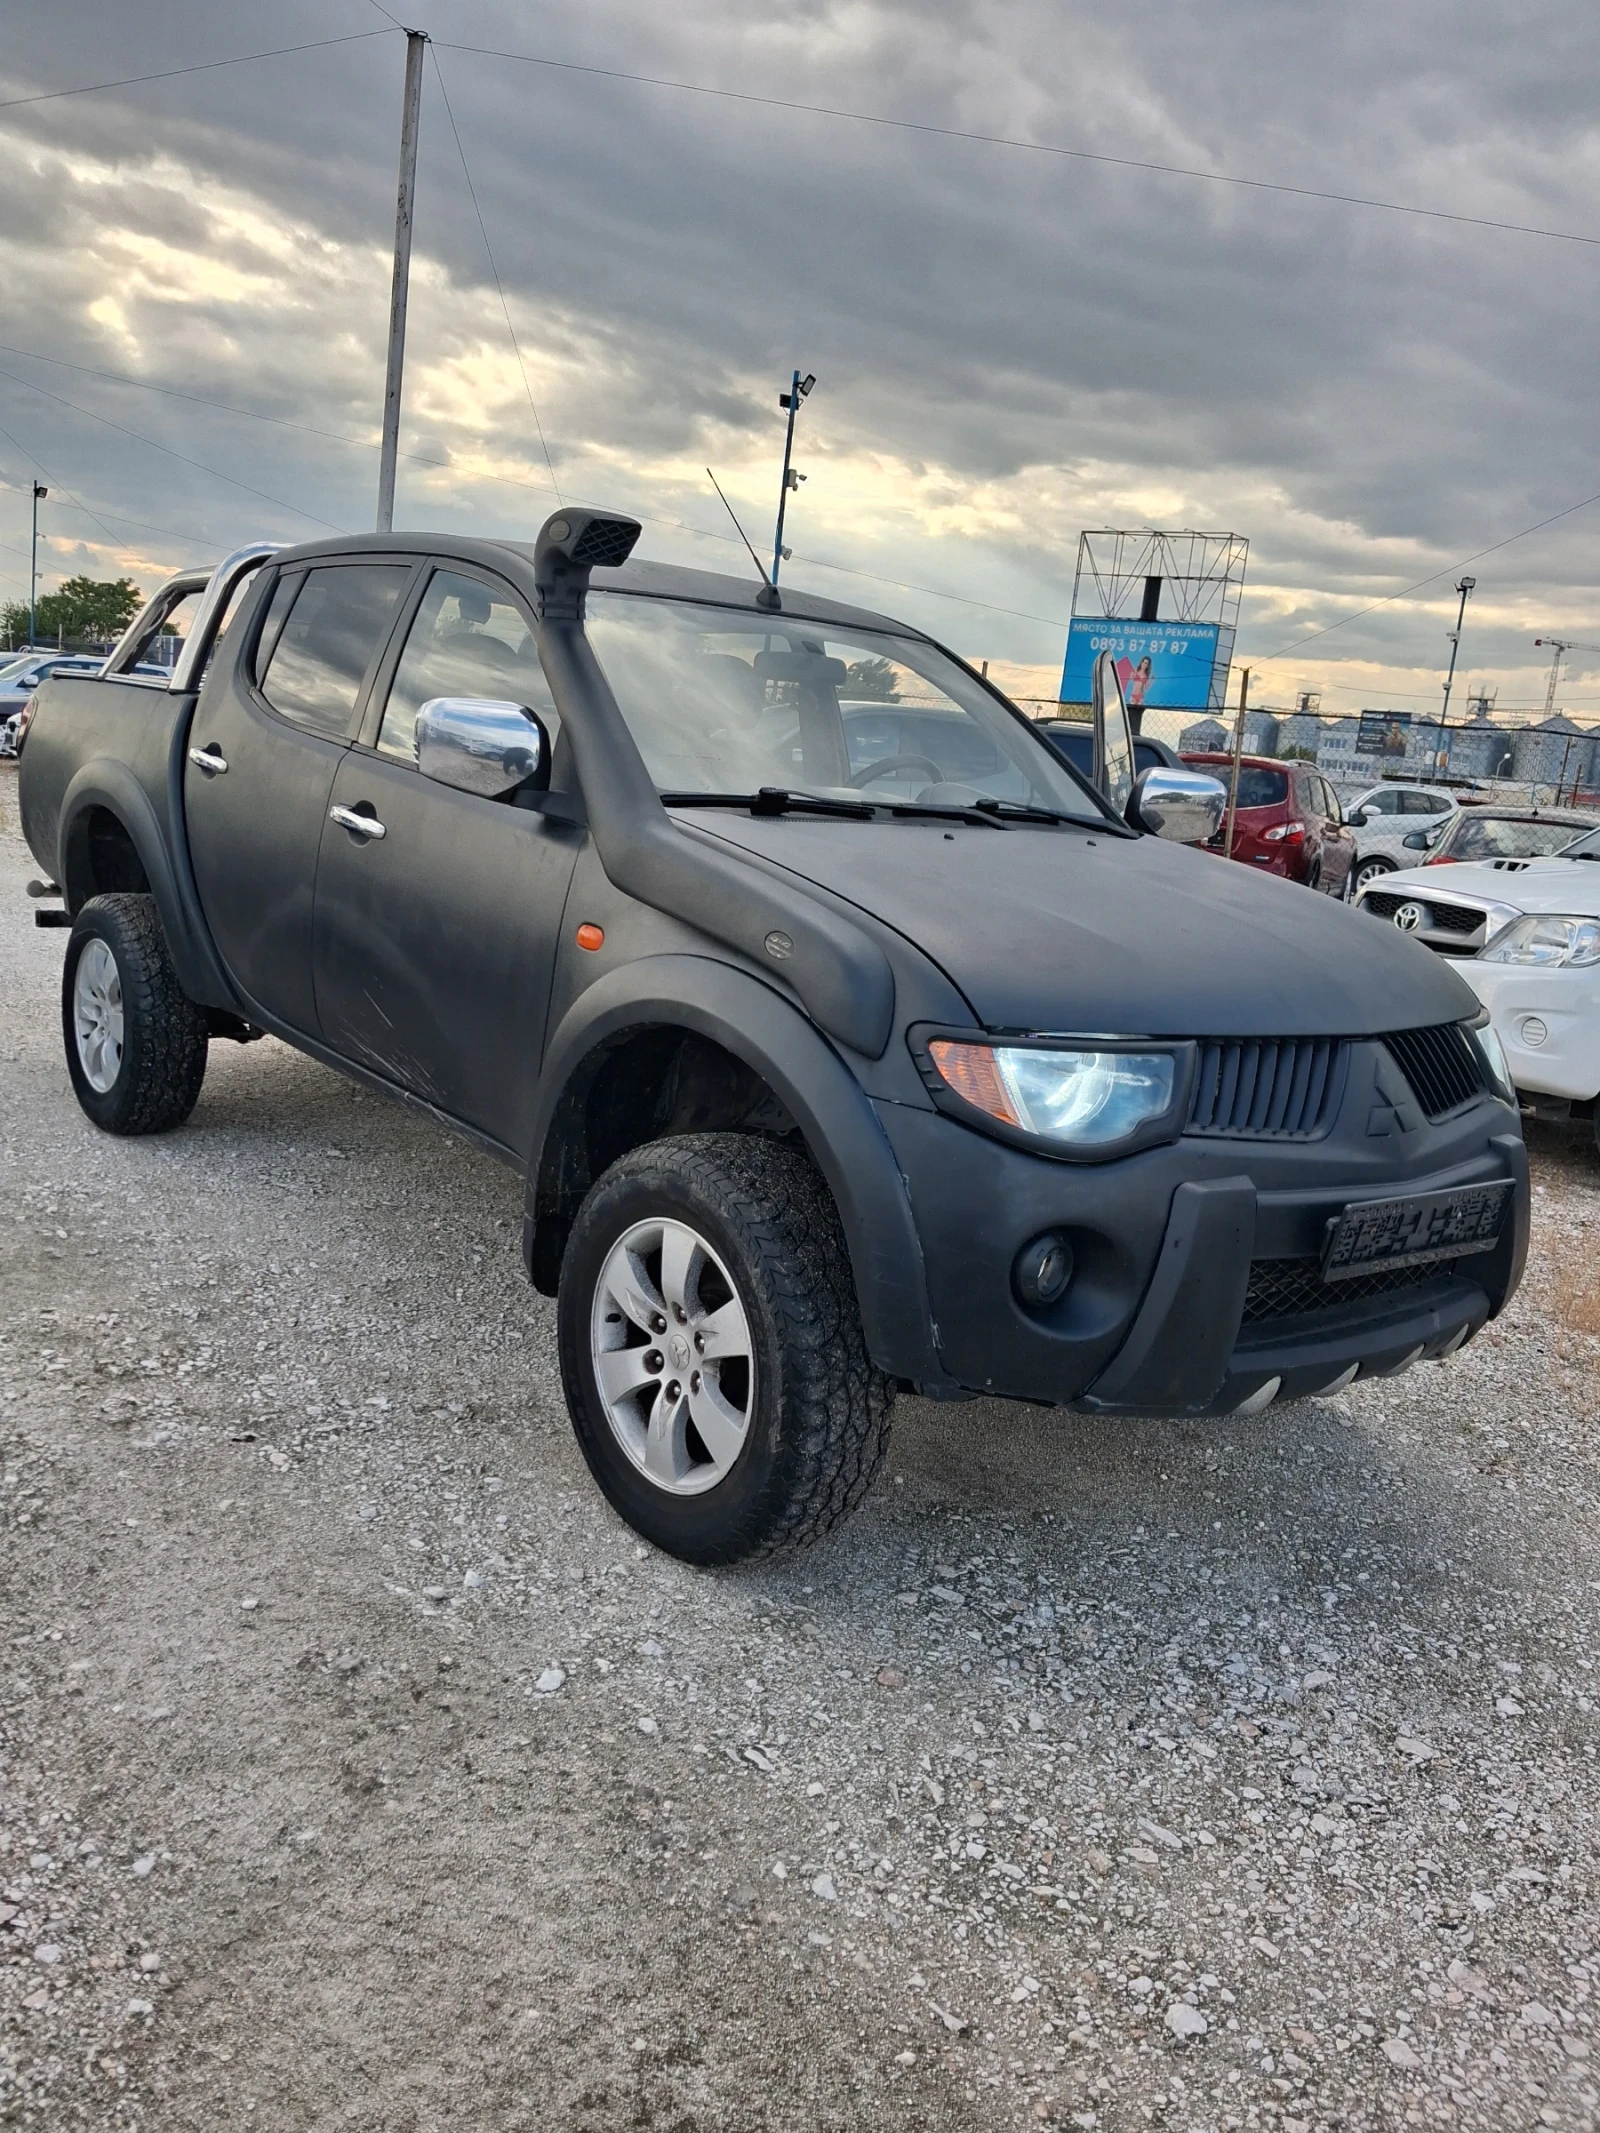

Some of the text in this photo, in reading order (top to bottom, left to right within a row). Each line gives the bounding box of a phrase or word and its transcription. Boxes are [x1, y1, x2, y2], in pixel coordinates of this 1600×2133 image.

[1073, 623, 1214, 638] МЯСТО ЗА ВАШАТА РЕКЛАМА
[1090, 637, 1188, 654] 0893 87 87 87
